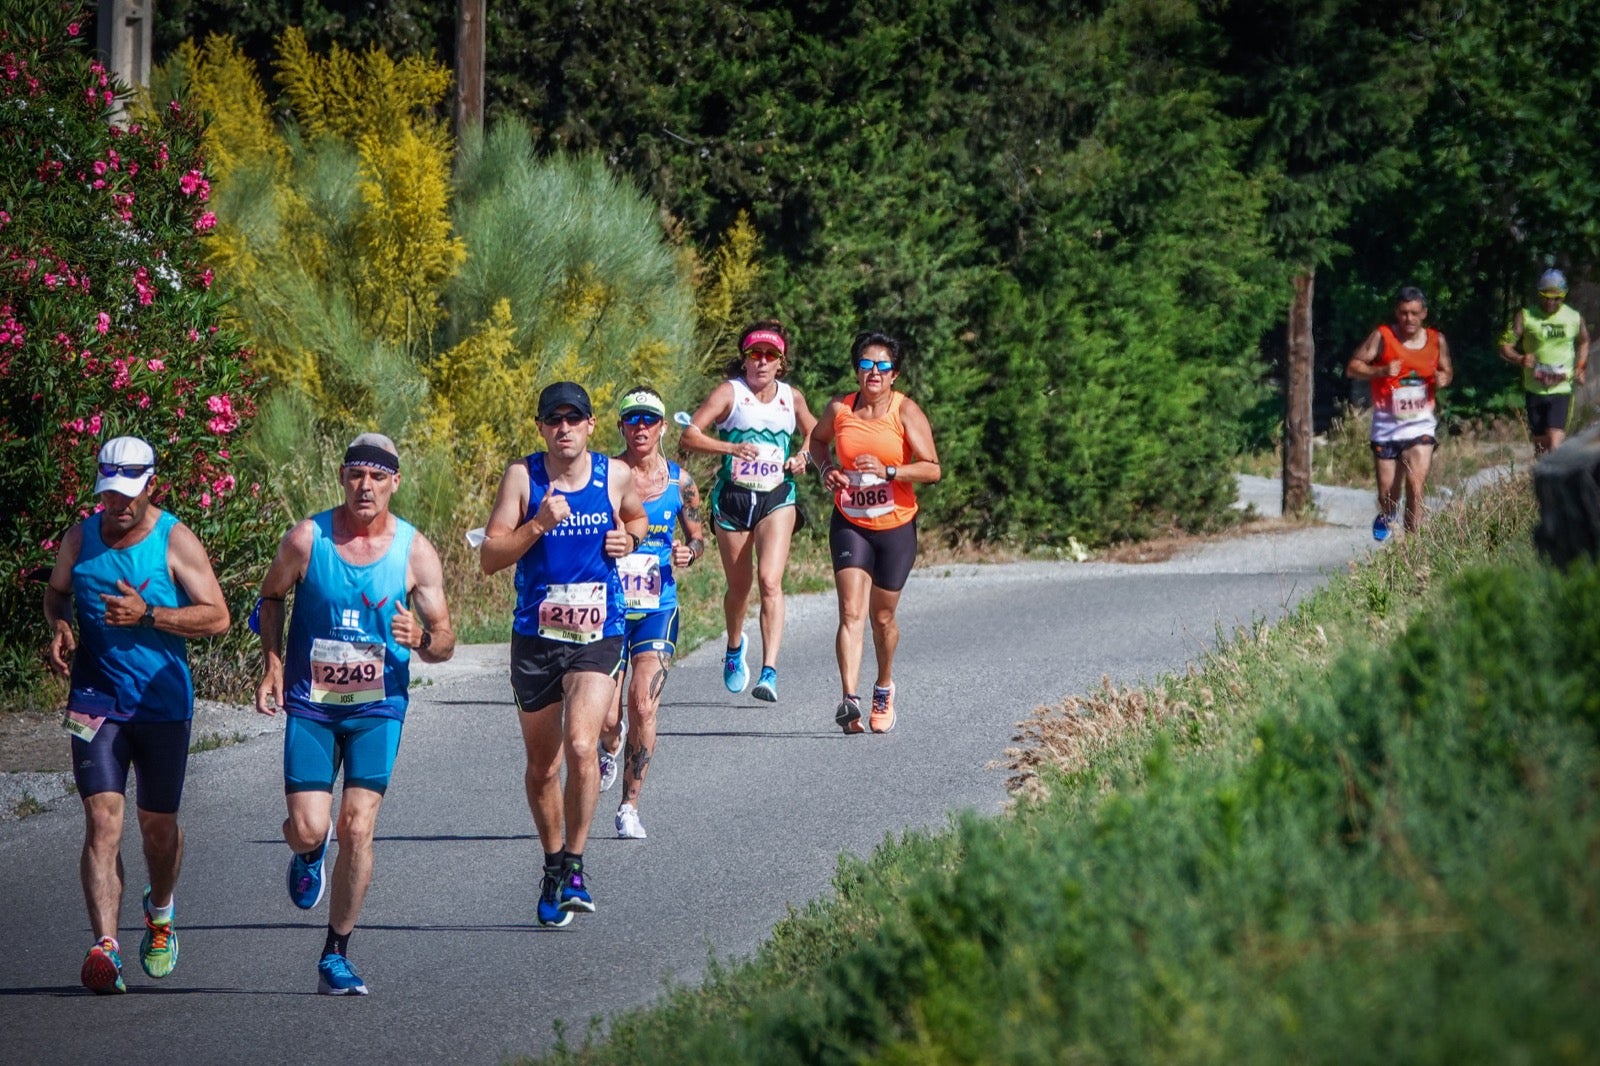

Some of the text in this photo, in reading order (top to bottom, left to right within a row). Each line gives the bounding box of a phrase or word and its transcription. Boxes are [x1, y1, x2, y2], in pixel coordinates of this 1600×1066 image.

[850, 489, 888, 506] 1086
[557, 511, 609, 528] stinos
[647, 524, 669, 535] mpo
[621, 574, 655, 591] 113
[625, 599, 642, 607] STINA
[550, 606, 600, 625] 2170
[323, 663, 376, 685] 2249
[340, 694, 354, 703] JOSE
